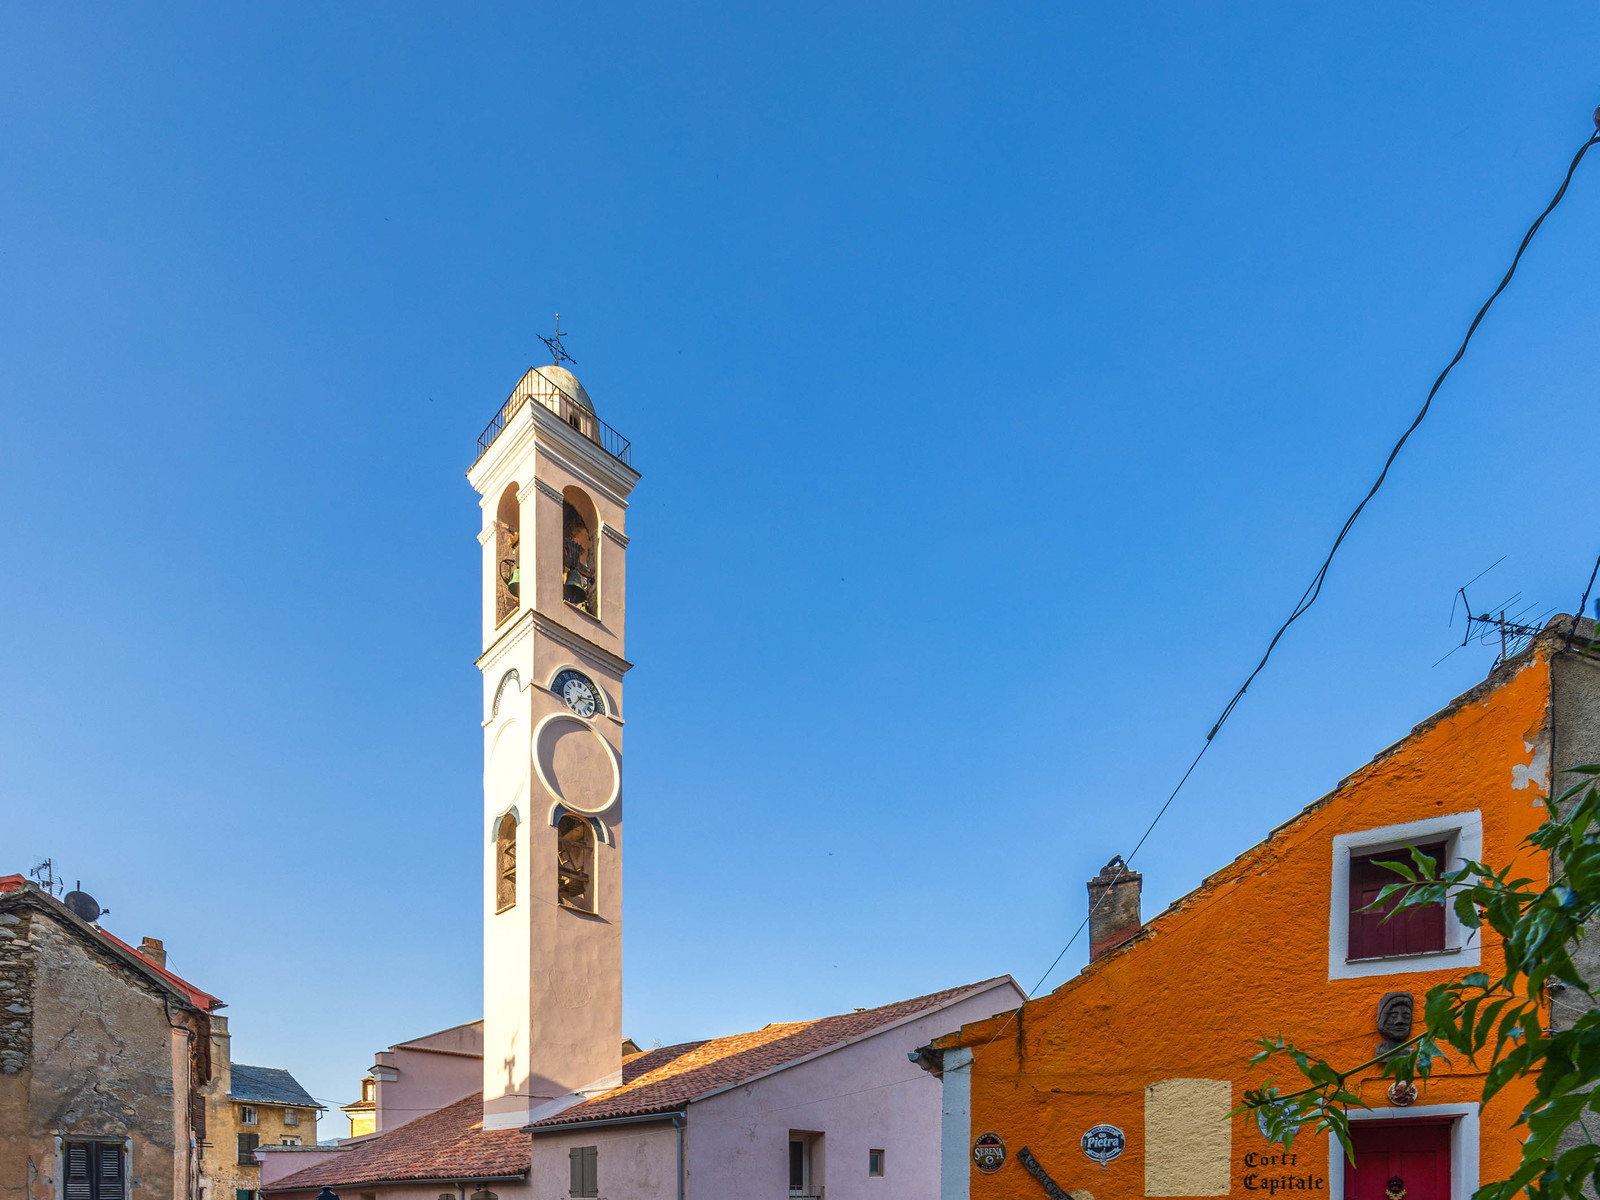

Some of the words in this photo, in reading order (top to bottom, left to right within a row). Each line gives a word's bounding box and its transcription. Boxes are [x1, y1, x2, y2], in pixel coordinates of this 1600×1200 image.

[1087, 1137, 1119, 1149] Pietra
[974, 1147, 1005, 1160] SERENA
[1244, 1152, 1298, 1168] Corti
[1243, 1174, 1325, 1195] Capitale
